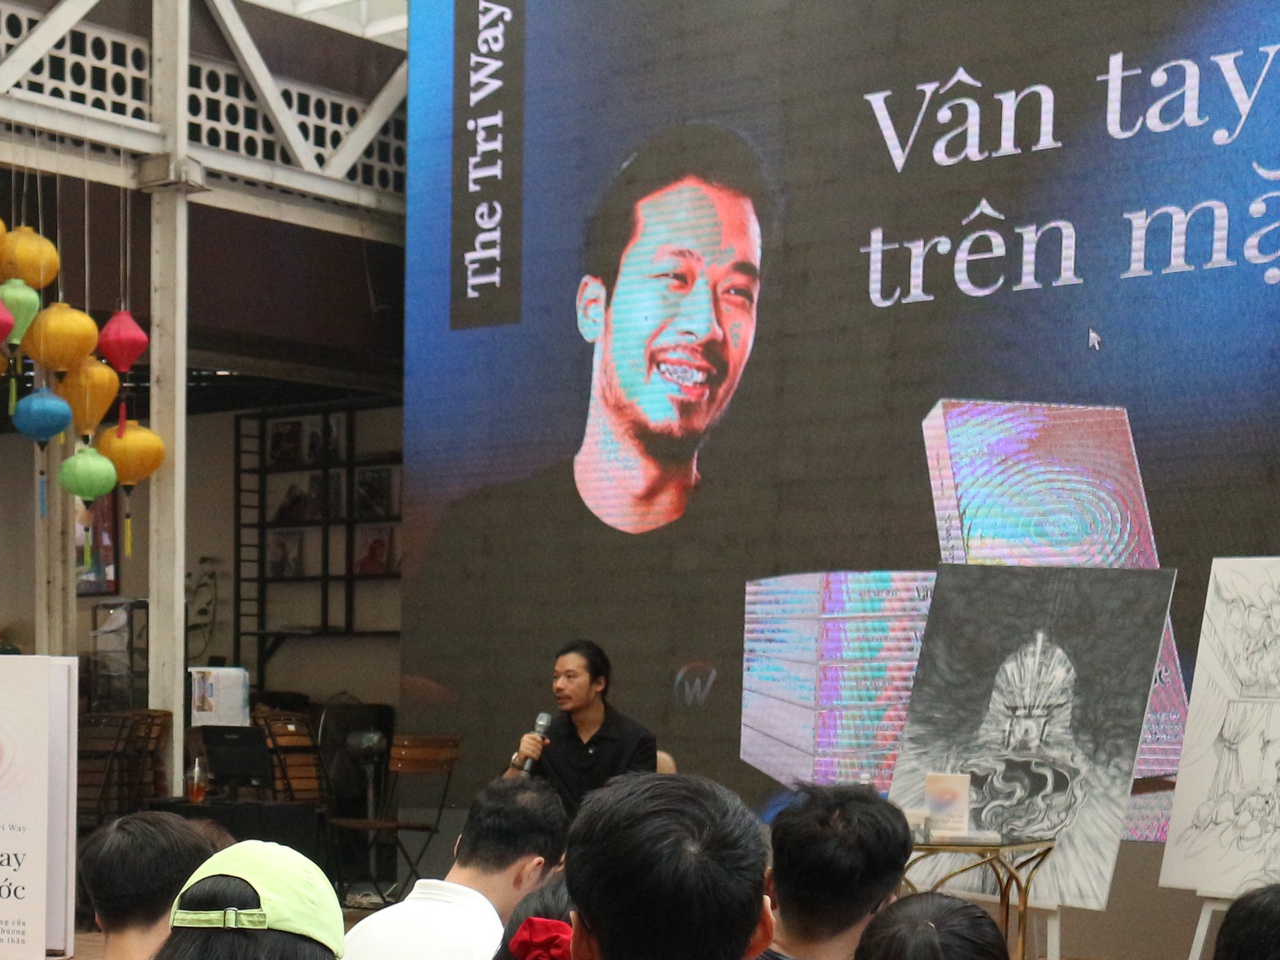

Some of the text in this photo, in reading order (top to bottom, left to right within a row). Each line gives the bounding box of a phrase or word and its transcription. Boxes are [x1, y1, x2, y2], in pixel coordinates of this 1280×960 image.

[464, 0, 512, 299] The Tri Way
[863, 44, 1280, 173] Vân tay
[860, 198, 1083, 308] trên
